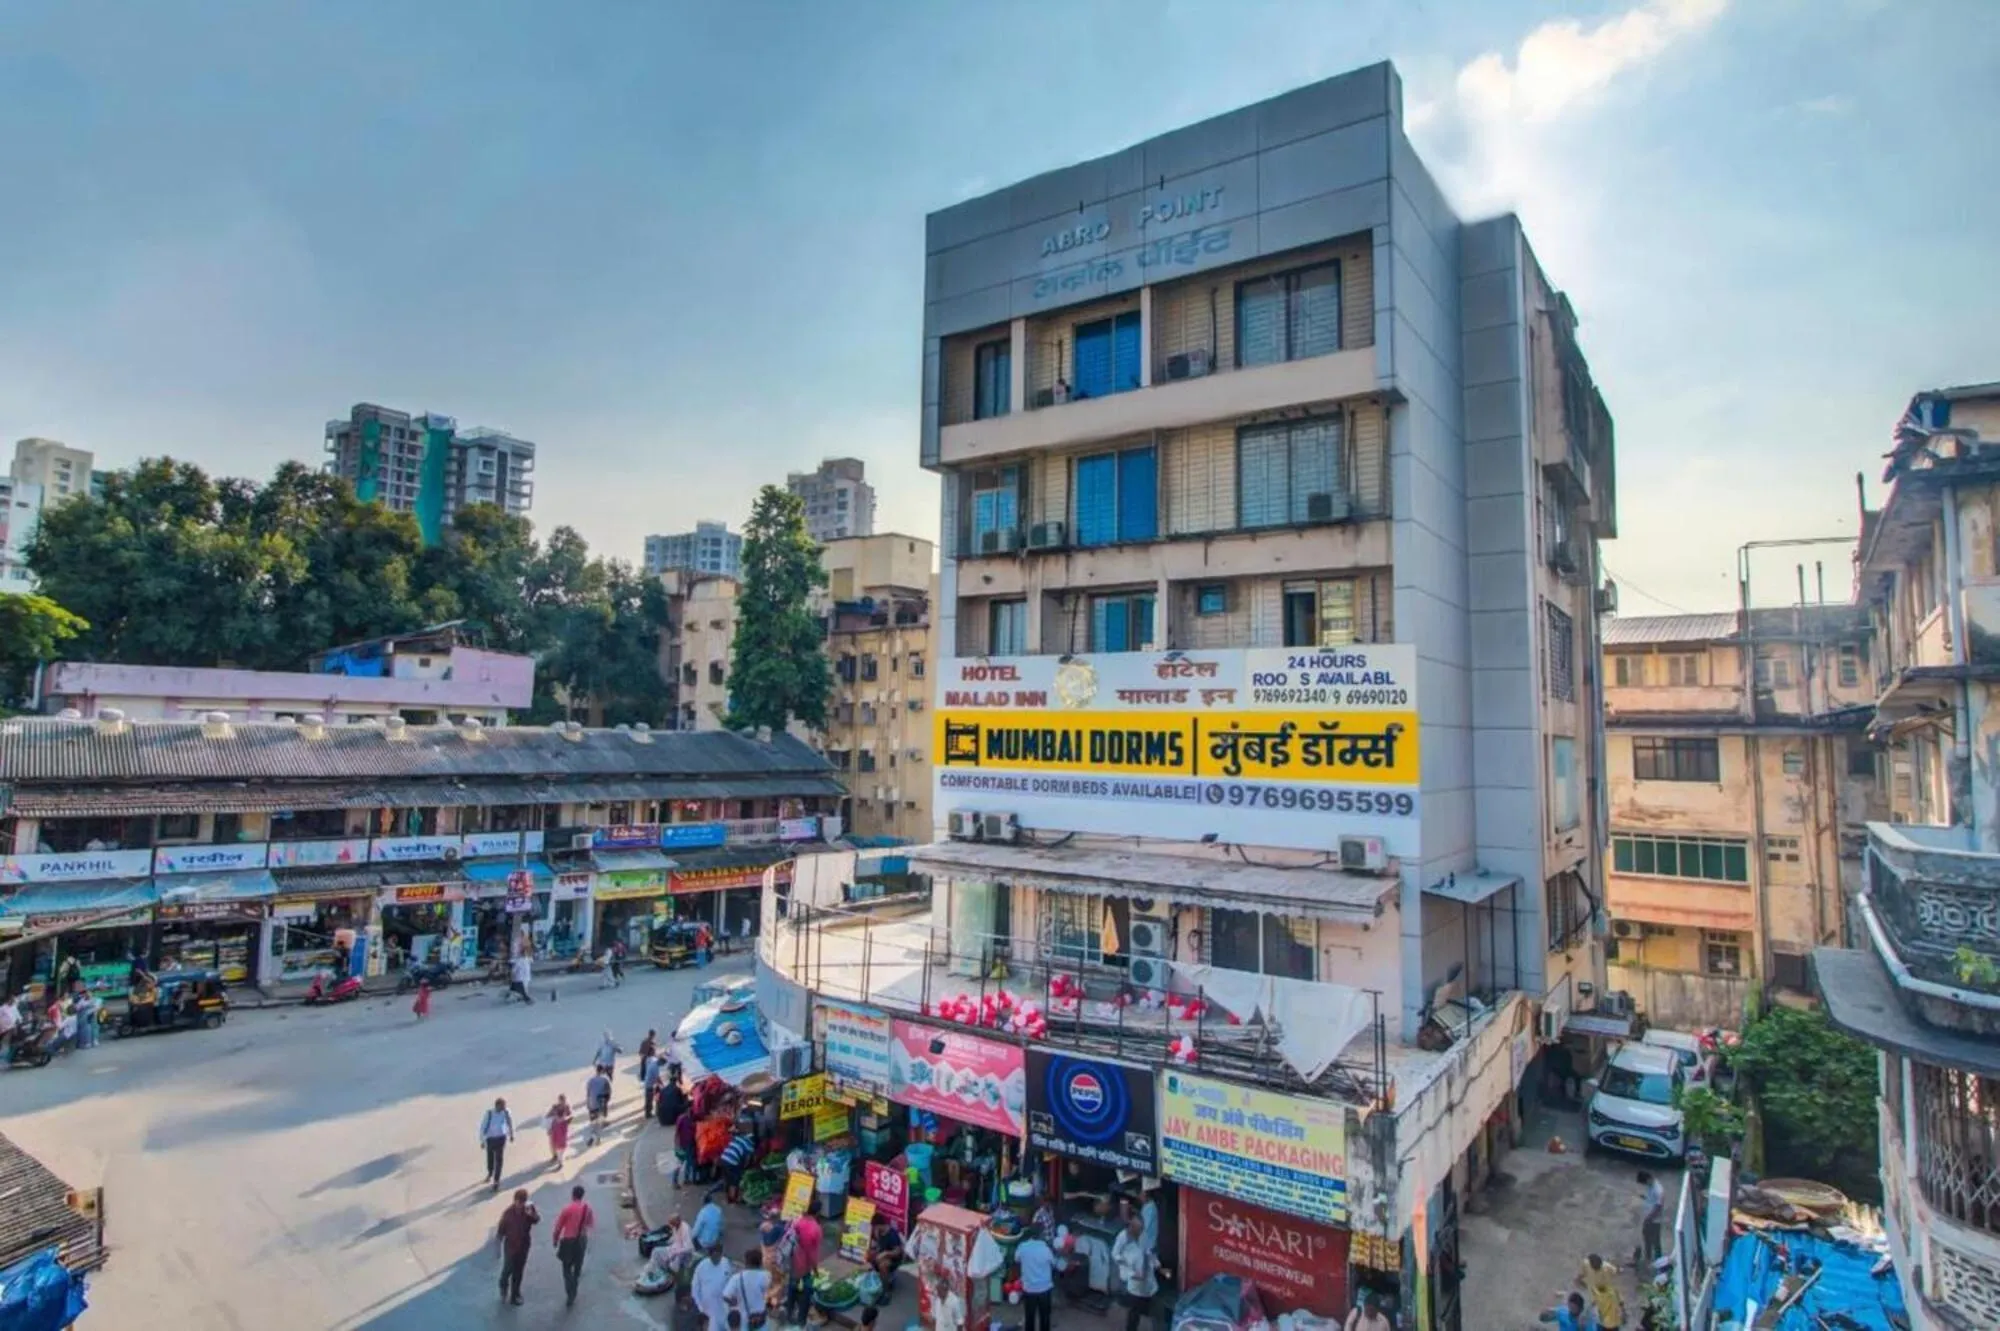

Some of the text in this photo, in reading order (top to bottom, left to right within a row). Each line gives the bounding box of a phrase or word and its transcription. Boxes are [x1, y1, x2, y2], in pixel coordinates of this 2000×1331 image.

[1041, 186, 1225, 258] ABRO POINT
[1288, 654, 1367, 668] 24 HOURS
[961, 665, 1022, 681] HOTEL
[945, 691, 1047, 706] MALAD INN
[1115, 689, 1237, 706] मालाड इन
[986, 728, 1183, 767] MUMBAI DORMS
[1208, 720, 1298, 776] मुंबई
[940, 774, 1028, 791] COMFORTABLE
[1032, 779, 1071, 794] DORM
[1072, 780, 1108, 795] BEDS
[1228, 784, 1414, 816] 9769695599
[40, 860, 116, 872] PANKHIL
[1072, 1087, 1100, 1097] PEPSI
[783, 1097, 823, 1113] XEROX
[1164, 1116, 1191, 1136] JAY
[1195, 1123, 1240, 1150] AMBE
[1244, 1134, 1343, 1176] PACKAGING
[1171, 1140, 1205, 1154] DEALERS
[1206, 1147, 1215, 1157] &
[1274, 1166, 1292, 1178] ALL
[1322, 1178, 1334, 1187] OF
[1213, 1246, 1315, 1288] FASHION INNERWEAR
